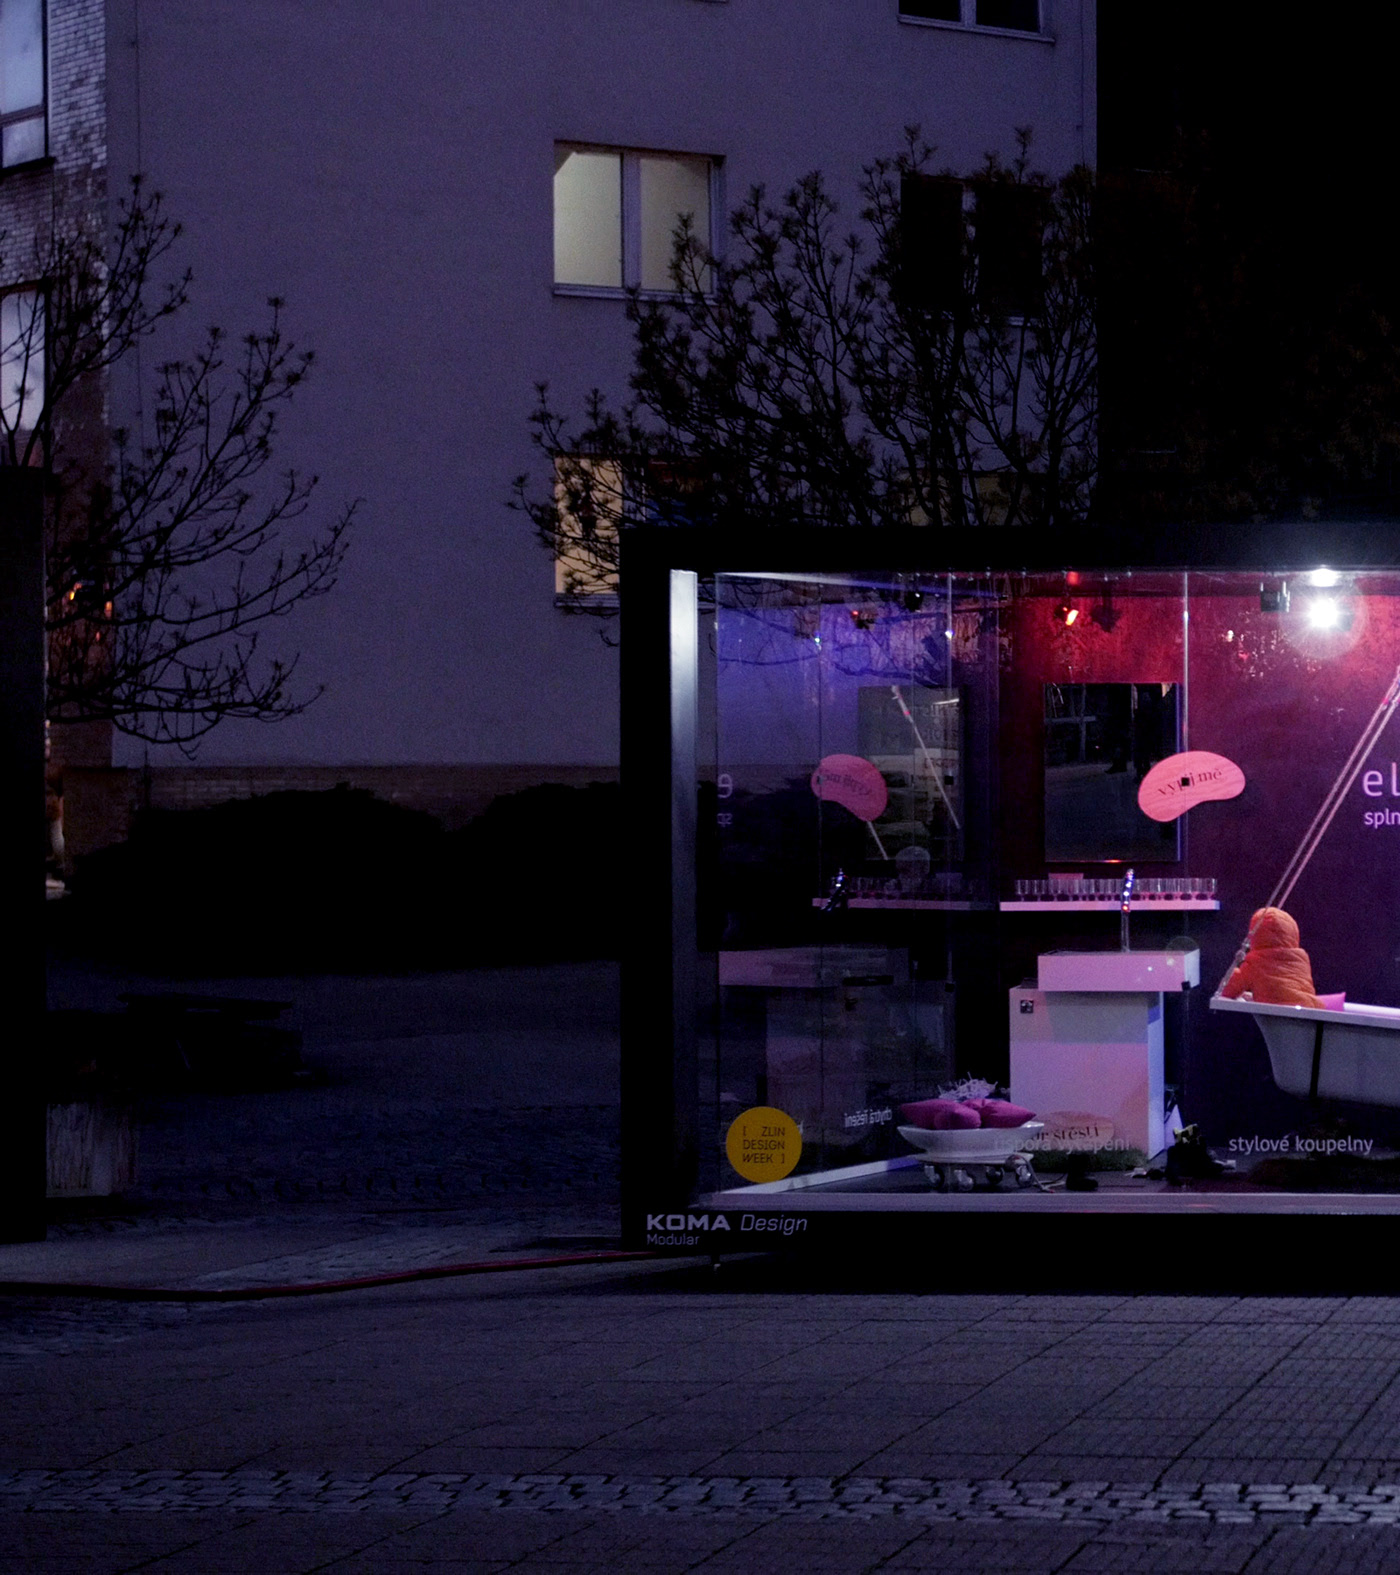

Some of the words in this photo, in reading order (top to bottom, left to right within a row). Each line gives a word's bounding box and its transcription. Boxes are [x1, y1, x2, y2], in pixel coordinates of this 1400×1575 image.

[761, 1126, 785, 1137] ZLIN
[742, 1139, 785, 1150] DESIGN
[1228, 1134, 1290, 1155] stylové
[1295, 1134, 1374, 1155] koupelny
[742, 1153, 774, 1164] WEEK
[646, 1213, 731, 1231] KOMA
[740, 1213, 808, 1236] Design
[646, 1233, 701, 1246] Modular
